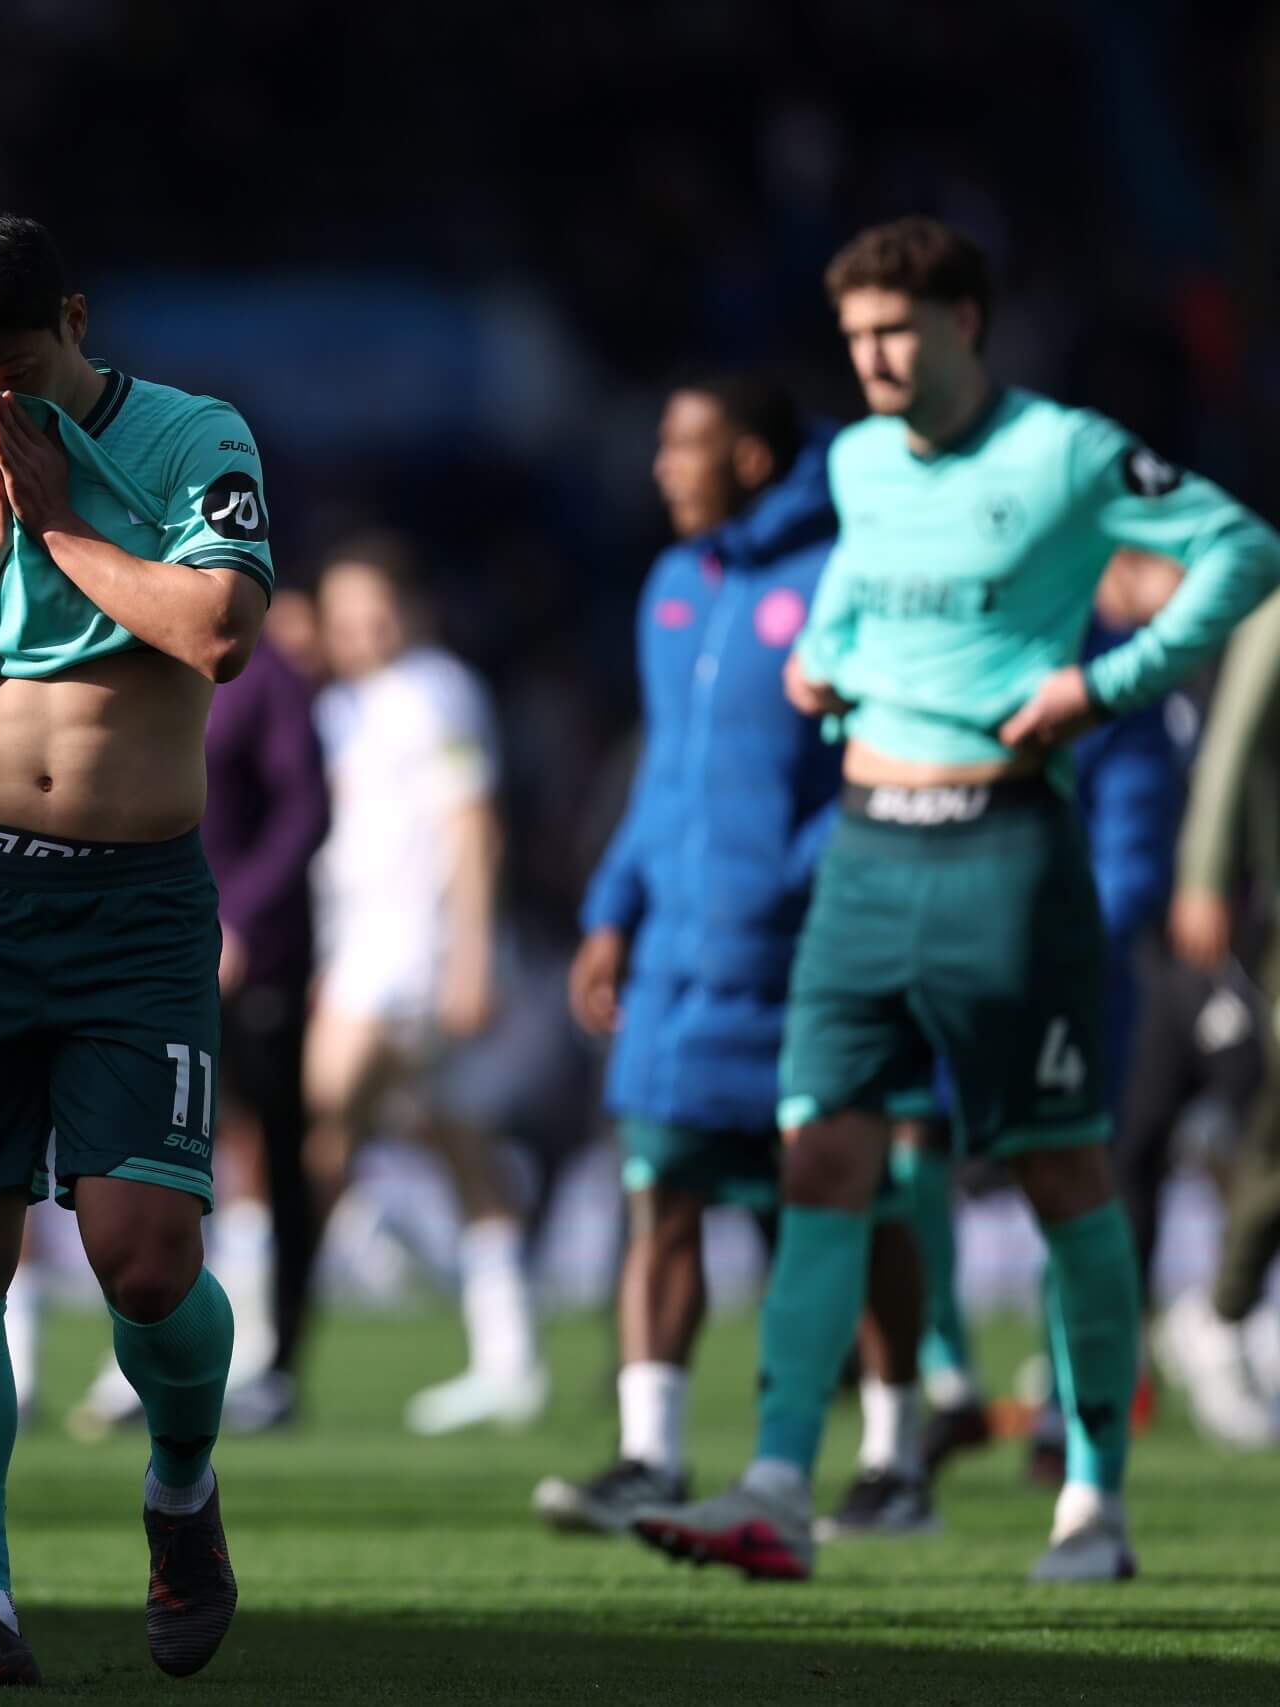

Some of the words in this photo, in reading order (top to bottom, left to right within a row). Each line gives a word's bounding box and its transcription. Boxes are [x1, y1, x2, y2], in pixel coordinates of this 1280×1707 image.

[165, 1043, 212, 1139] 11
[1035, 1016, 1086, 1093] 4
[163, 1133, 210, 1158] SUDU
